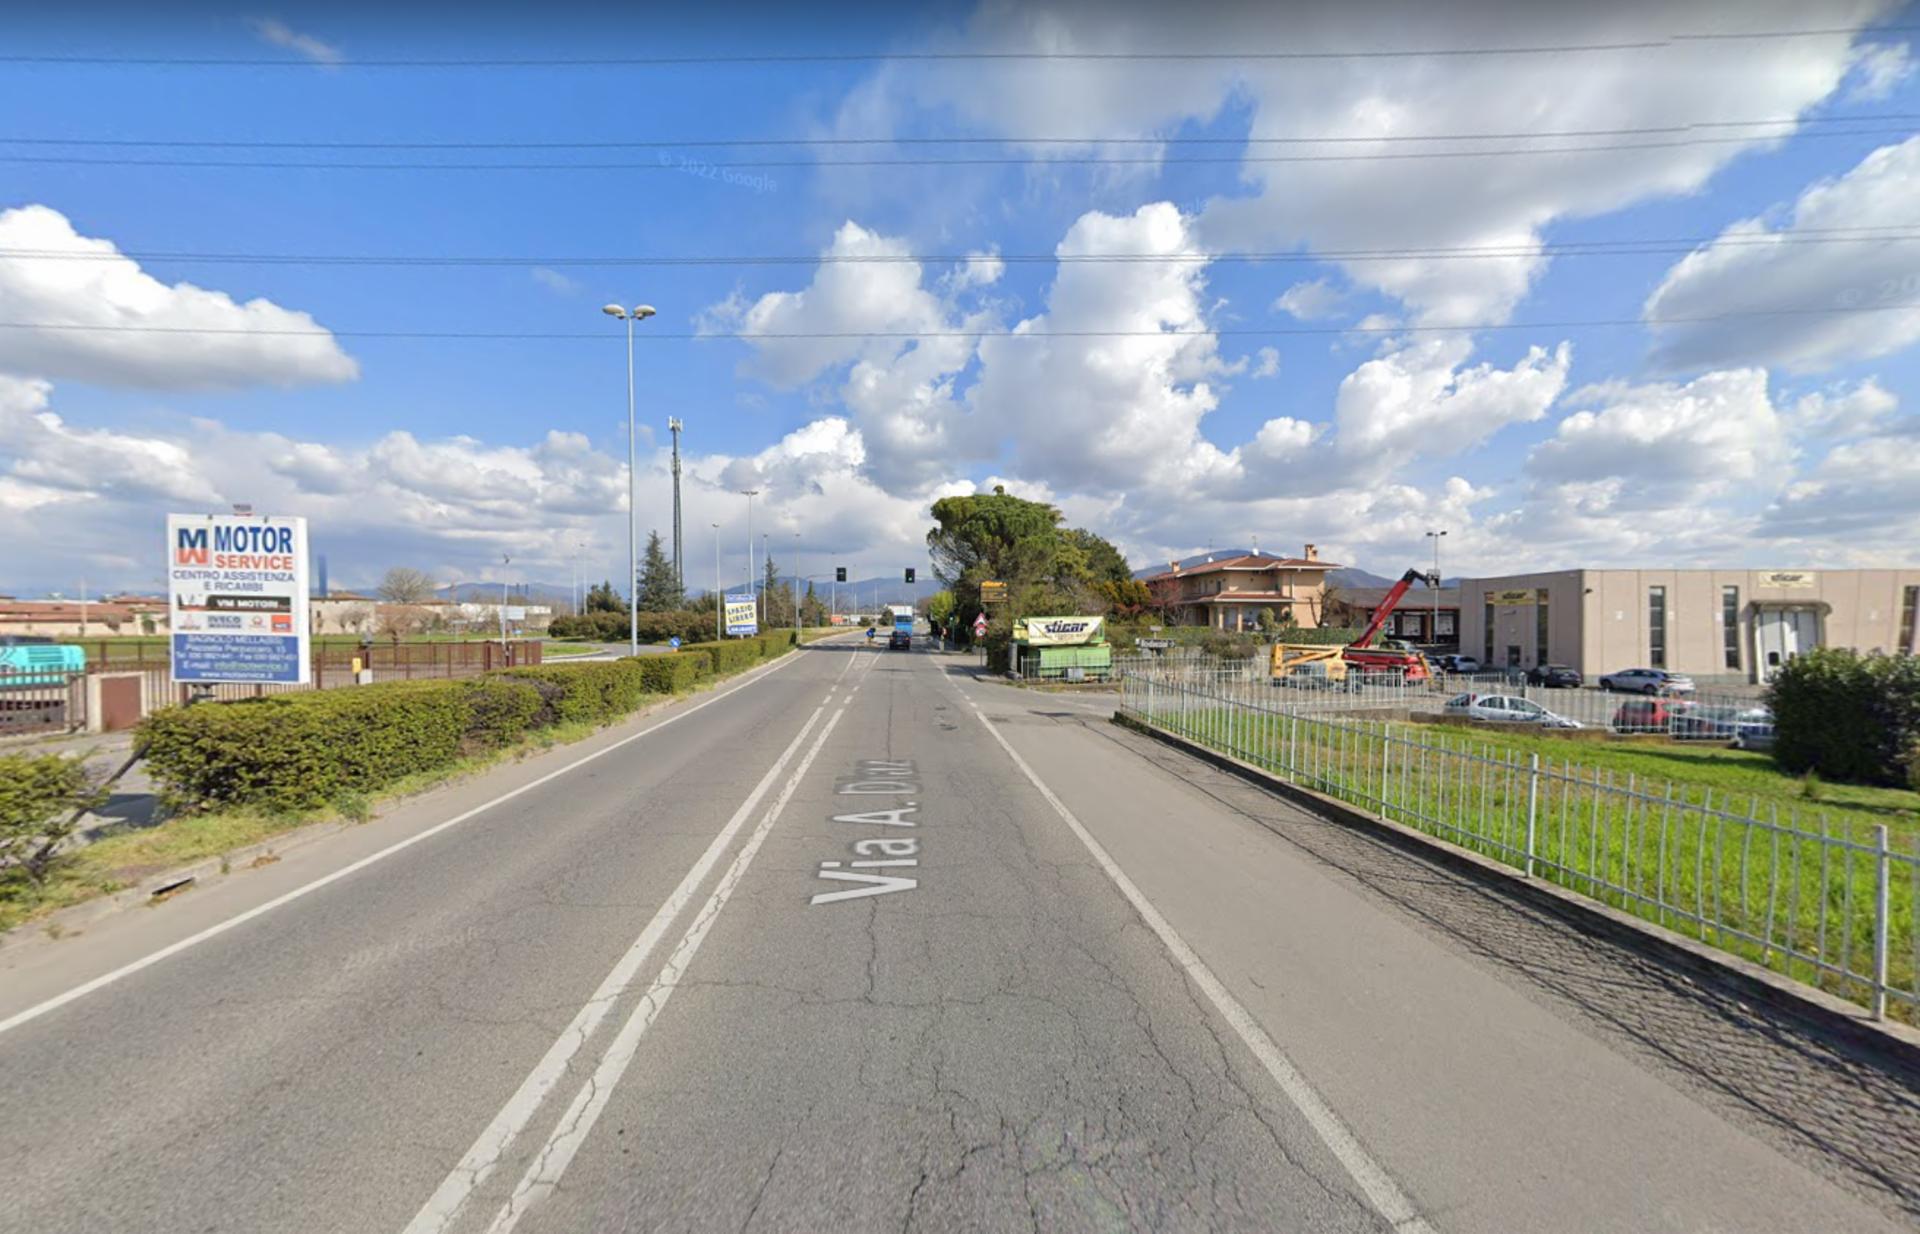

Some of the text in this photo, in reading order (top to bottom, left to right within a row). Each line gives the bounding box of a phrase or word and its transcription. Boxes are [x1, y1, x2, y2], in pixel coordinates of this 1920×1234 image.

[214, 525, 293, 554] MOTOR
[215, 554, 294, 570] SERVICE
[173, 570, 296, 582] CENTRO ASSISTENZA
[204, 582, 264, 591] E RICAMBI
[1045, 619, 1089, 634] sticar
